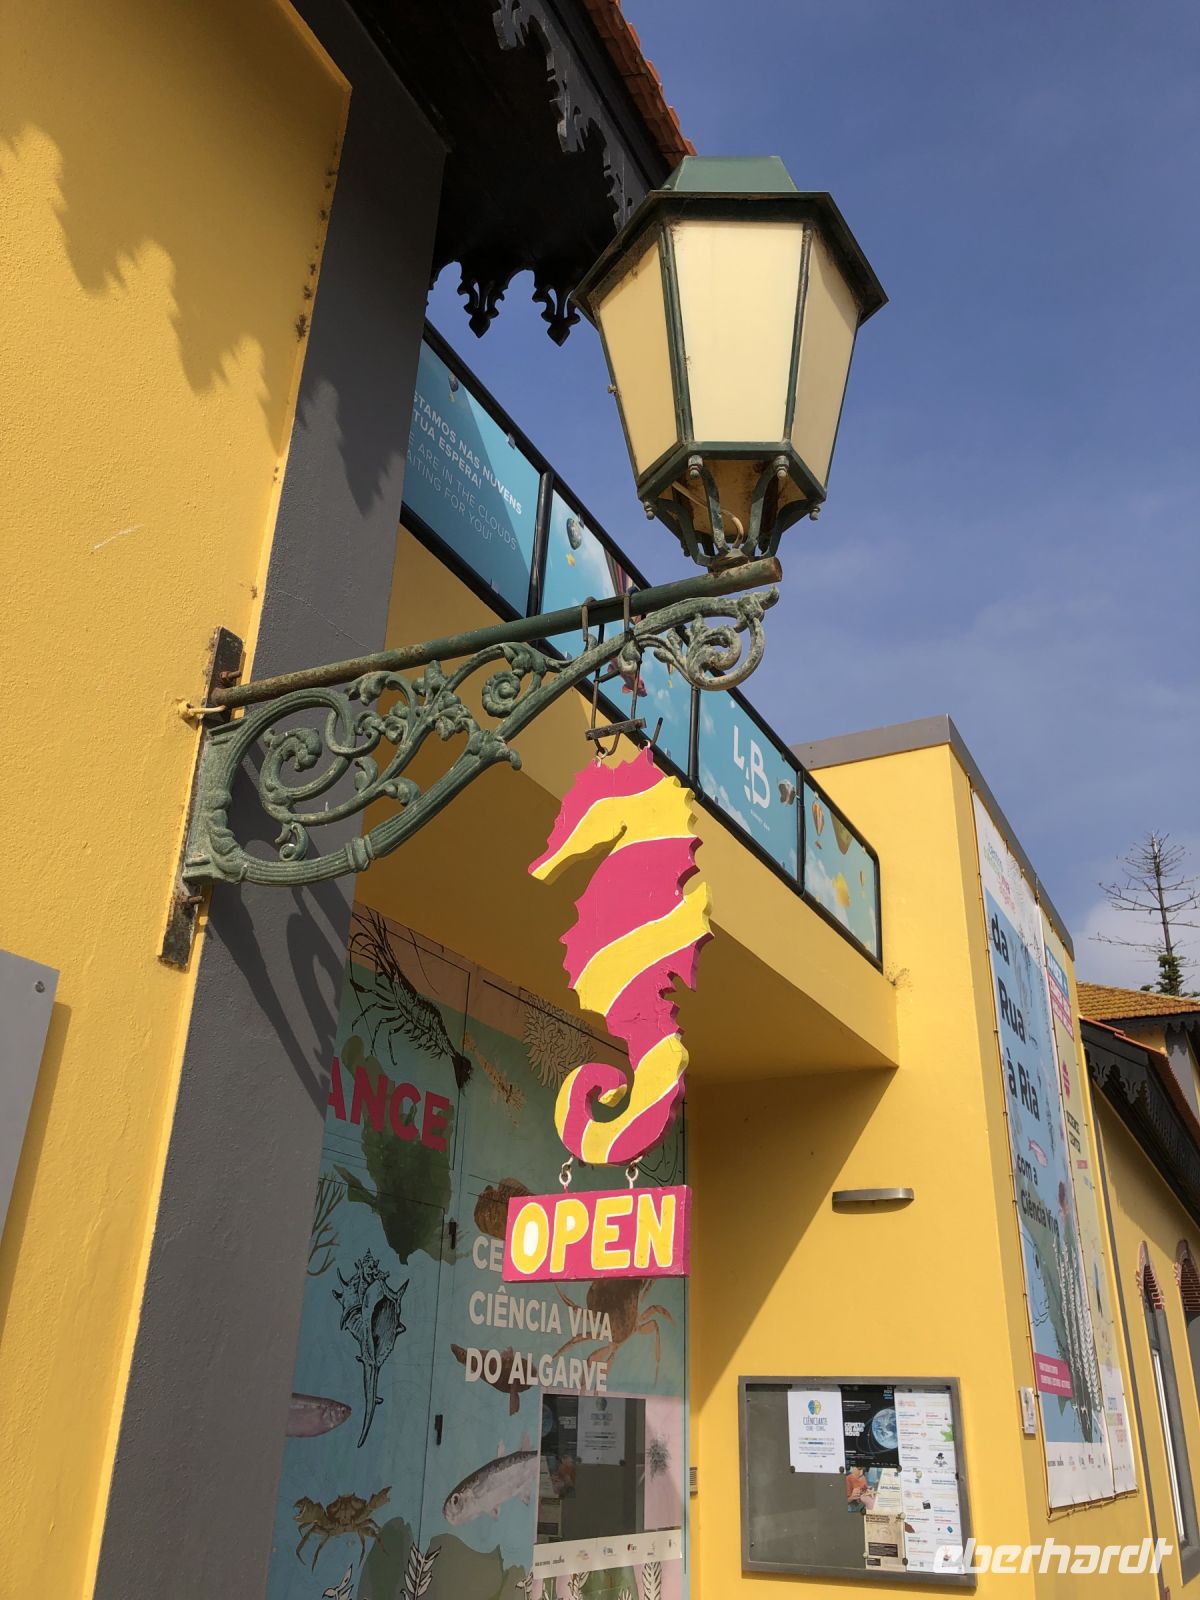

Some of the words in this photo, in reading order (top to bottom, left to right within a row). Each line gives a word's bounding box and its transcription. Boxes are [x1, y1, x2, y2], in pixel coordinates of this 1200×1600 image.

[413, 409, 436, 441] TUA
[438, 436, 482, 489] ESPERA!
[458, 440, 480, 469] NAS
[482, 466, 522, 515] NUVENS
[418, 443, 440, 468] ARE
[442, 465, 453, 485] IN
[456, 480, 476, 508] THE
[478, 505, 517, 551] CLOUDS
[444, 488, 466, 516] FOR
[468, 512, 493, 542] YOU!
[991, 913, 1010, 966] da
[998, 976, 1026, 1044] Rua
[1006, 1047, 1017, 1099] à
[1017, 1062, 1040, 1122] Ria
[1016, 1153, 1033, 1182] com
[1033, 1166, 1039, 1186] a
[510, 1193, 677, 1275] OPEN
[469, 1285, 562, 1336] CIÊNCIA
[568, 1306, 613, 1343] VIVA
[464, 1347, 501, 1385] DO
[508, 1351, 608, 1393] ALGARVE
